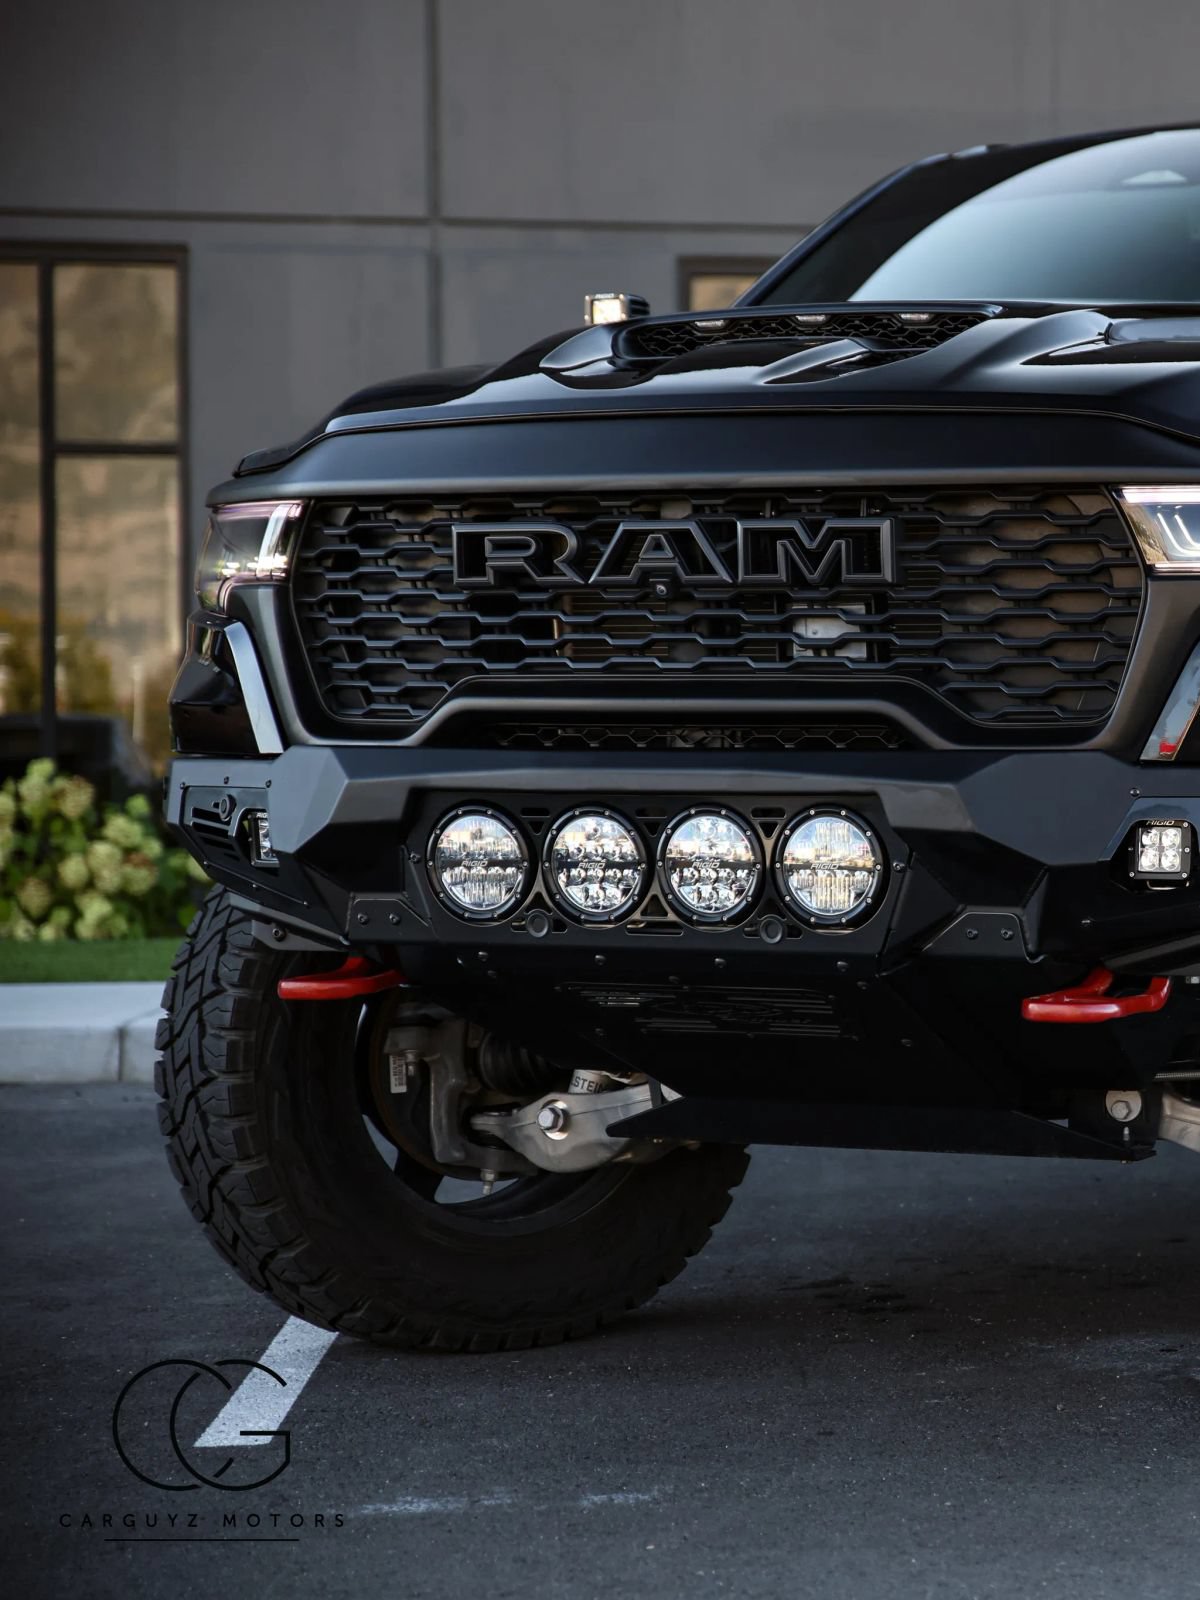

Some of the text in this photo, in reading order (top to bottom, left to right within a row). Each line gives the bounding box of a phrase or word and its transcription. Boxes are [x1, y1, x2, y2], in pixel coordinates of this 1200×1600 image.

[452, 518, 897, 585] RAM
[461, 859, 489, 867] RIGID
[578, 861, 606, 869] RIGID
[692, 861, 720, 869] RIGID
[810, 862, 839, 870] RIGID
[570, 1075, 602, 1094] STEI
